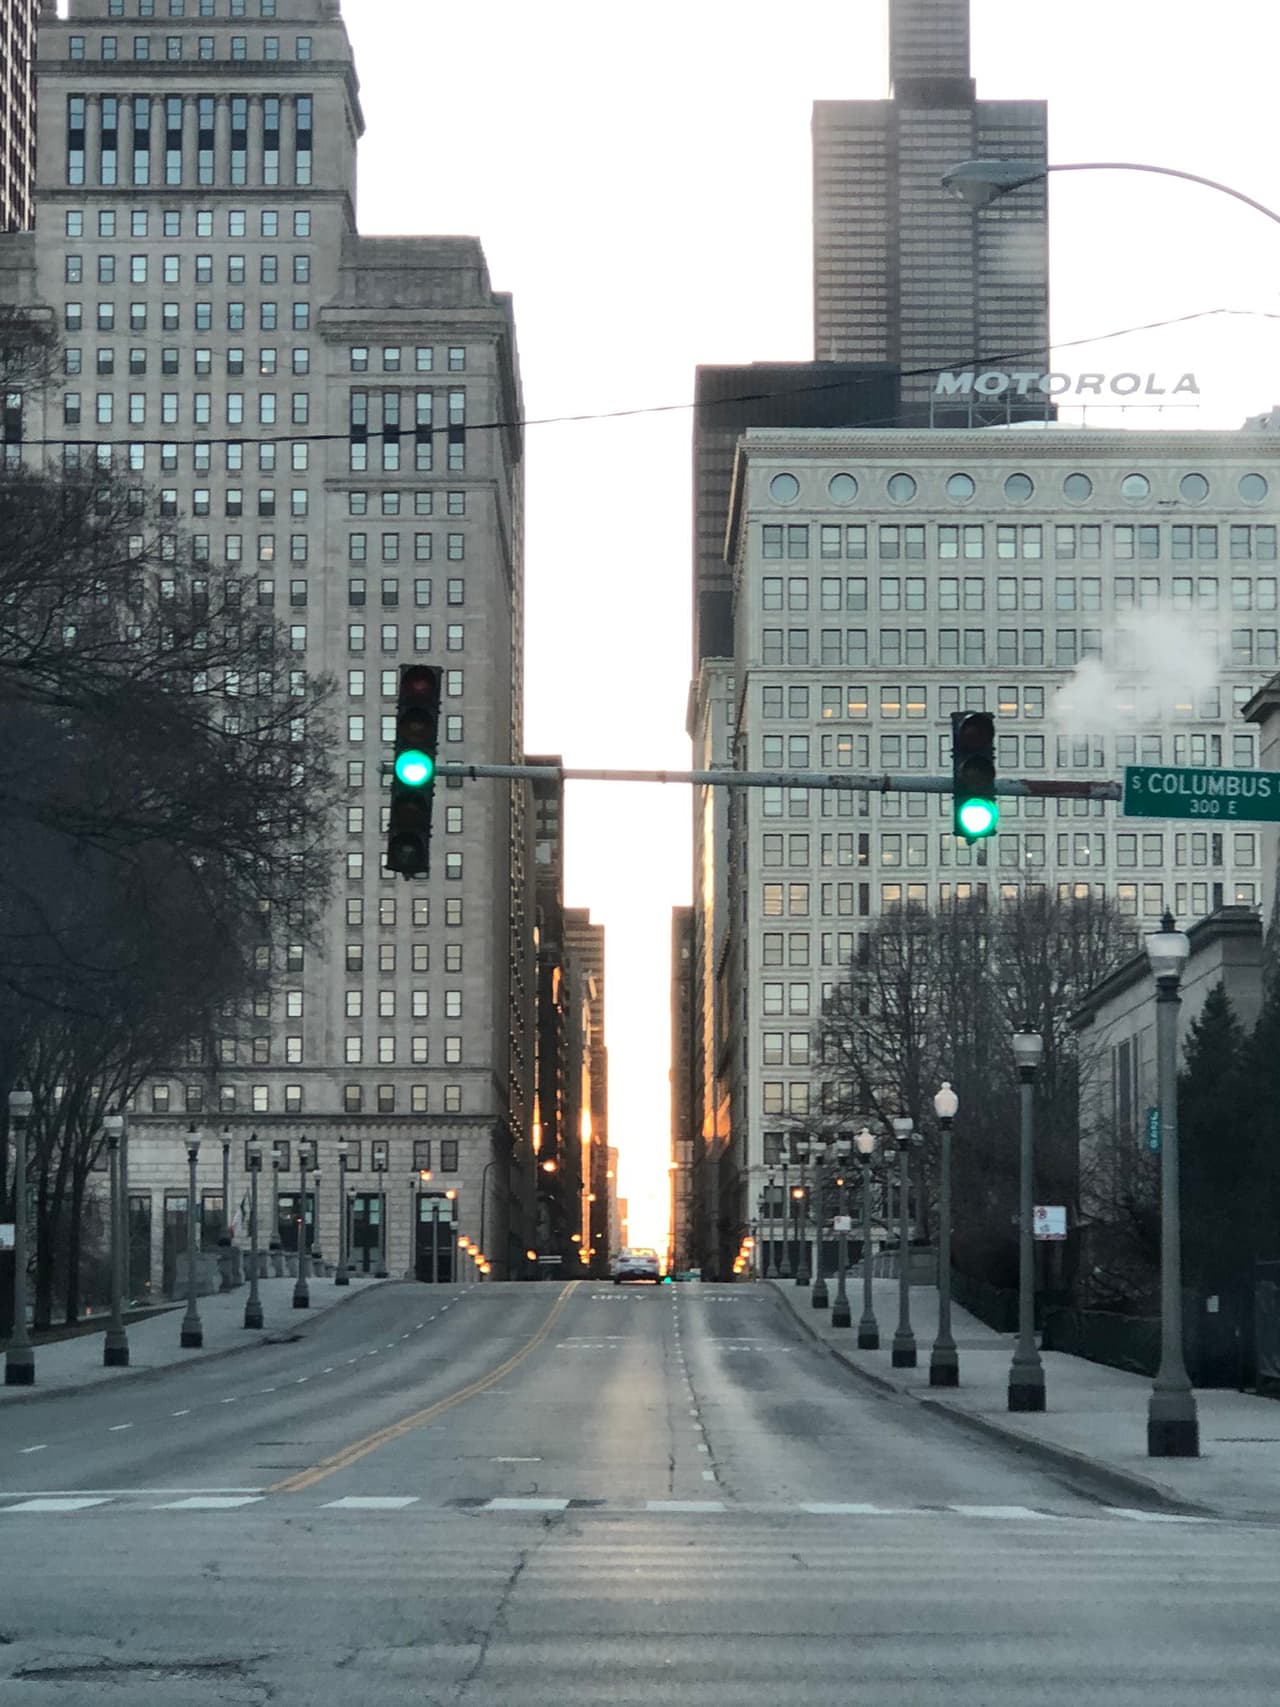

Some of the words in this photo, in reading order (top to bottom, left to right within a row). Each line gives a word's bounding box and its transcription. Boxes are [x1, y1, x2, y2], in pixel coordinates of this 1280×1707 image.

[935, 372, 1200, 395] MOTOROLA
[1132, 775, 1142, 790] S
[1148, 773, 1271, 798] COLUMBUS
[1190, 800, 1220, 814] 300
[1228, 801, 1237, 814] E
